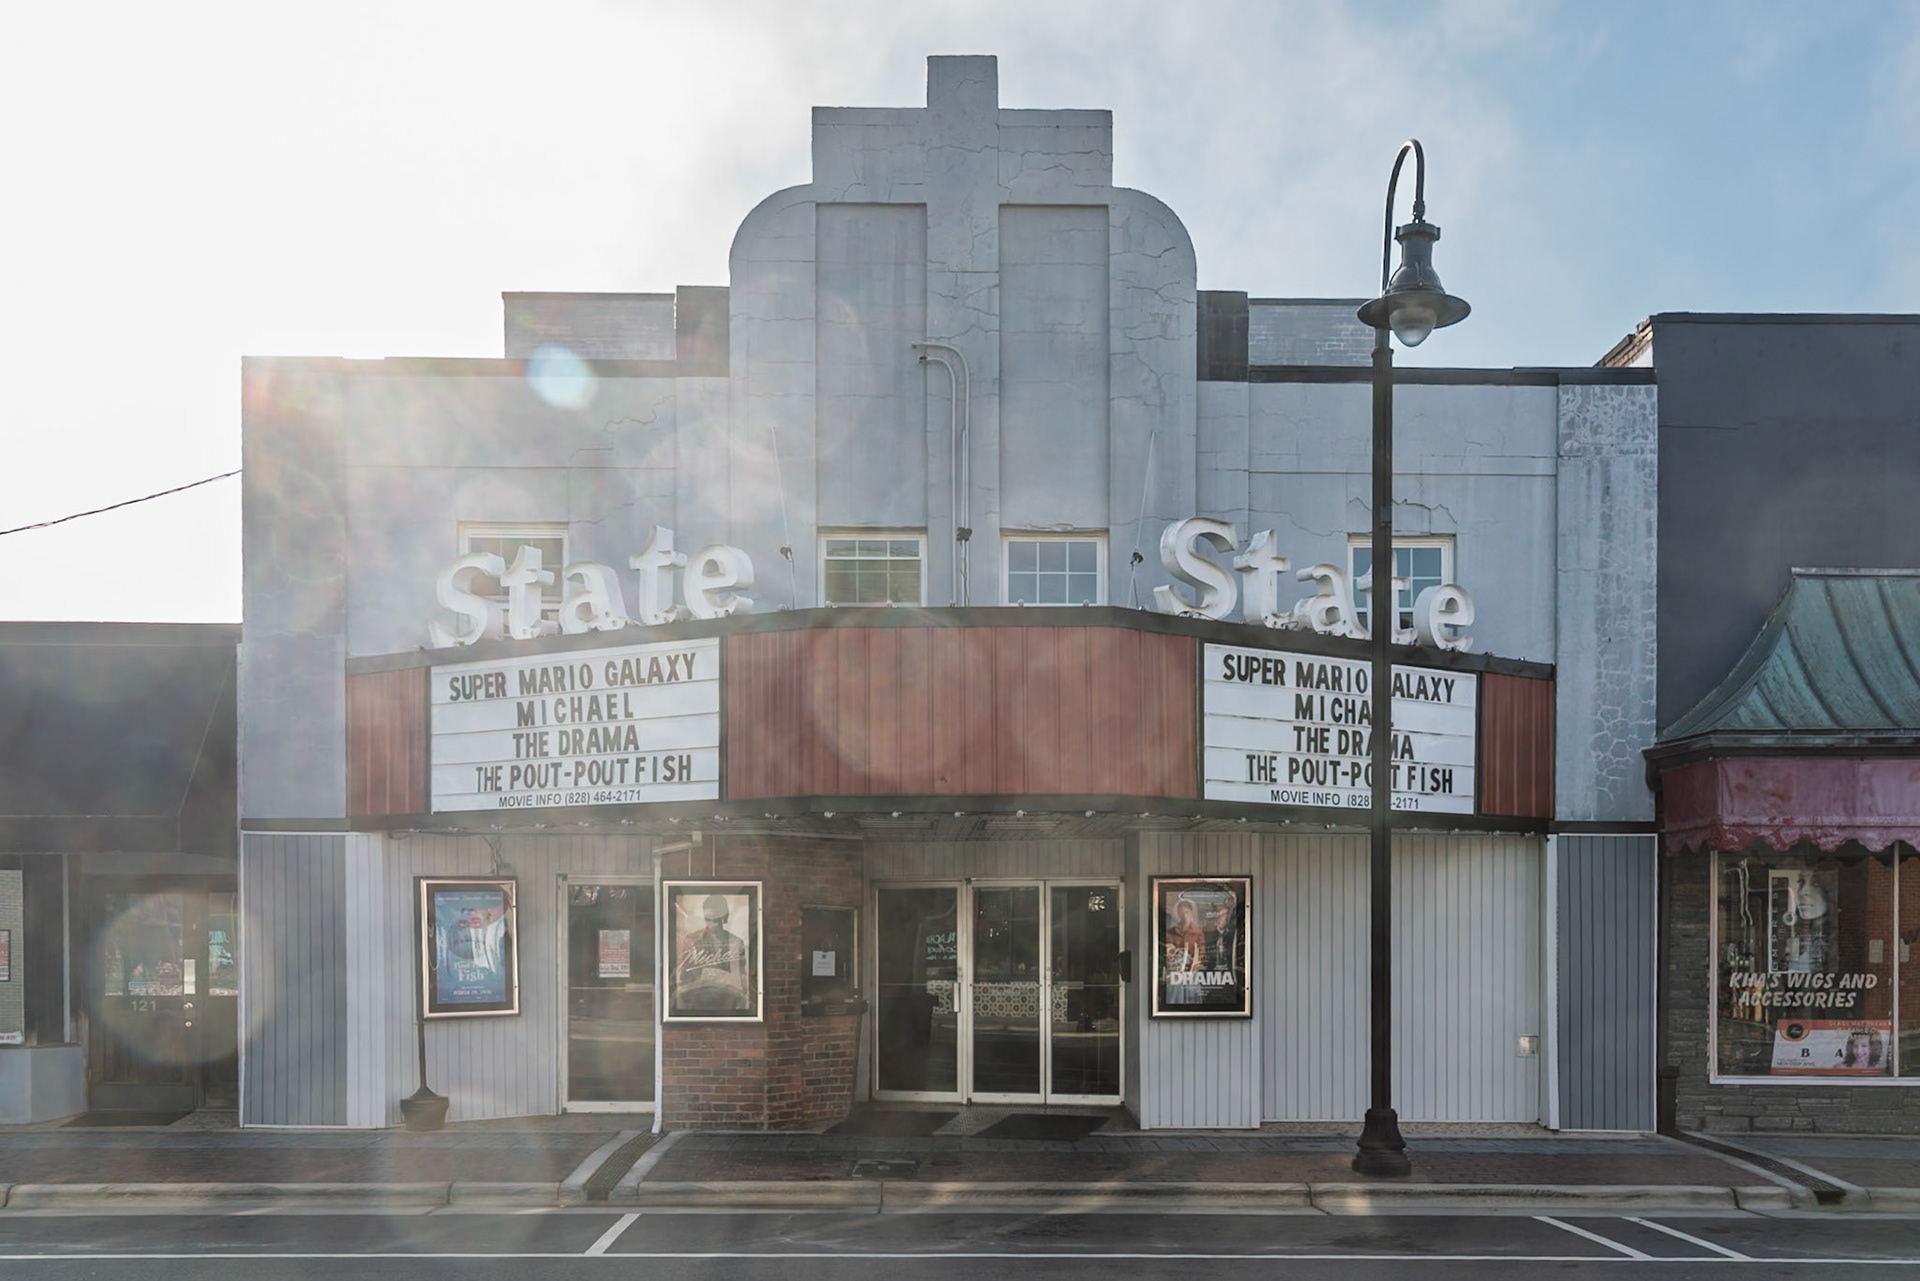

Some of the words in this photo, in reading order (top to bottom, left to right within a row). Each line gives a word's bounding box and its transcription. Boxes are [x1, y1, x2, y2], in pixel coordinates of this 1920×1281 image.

[429, 525, 754, 649] State
[1154, 517, 1475, 652] State
[449, 672, 507, 701] SUPER
[518, 663, 593, 695] MARIO
[605, 653, 696, 687] GALAXY
[1223, 654, 1286, 686] SUPER
[1296, 661, 1368, 694] MARIO
[1389, 672, 1455, 703] ALAXY
[516, 692, 634, 727] MICHAEL
[1295, 693, 1394, 728] MICHA
[512, 731, 549, 758] THE
[558, 725, 639, 755] DRAMA
[1293, 726, 1330, 754] THE
[476, 765, 503, 792] THE
[510, 758, 629, 790] POUT-POUT
[635, 754, 692, 783] FISH
[1246, 754, 1278, 783] THE
[1288, 757, 1401, 789] POUT-POT
[1407, 765, 1453, 794] FISH
[499, 795, 533, 807] MOVIE
[536, 793, 562, 805] INFO
[565, 791, 591, 806] (828)
[593, 789, 641, 802] 464-2171
[1270, 790, 1309, 803] MOVIE
[1312, 792, 1341, 805] INFO
[1347, 794, 1372, 807] (828
[1169, 971, 1235, 986] DRAMA
[1729, 972, 1781, 988] KIM'S
[1787, 973, 1835, 989] WIGS
[1839, 973, 1878, 989] AND
[130, 1000, 156, 1012] 121
[1738, 991, 1857, 1008] ACCESSORIES
[1801, 1048, 1811, 1058] B
[1834, 1048, 1844, 1058] A
